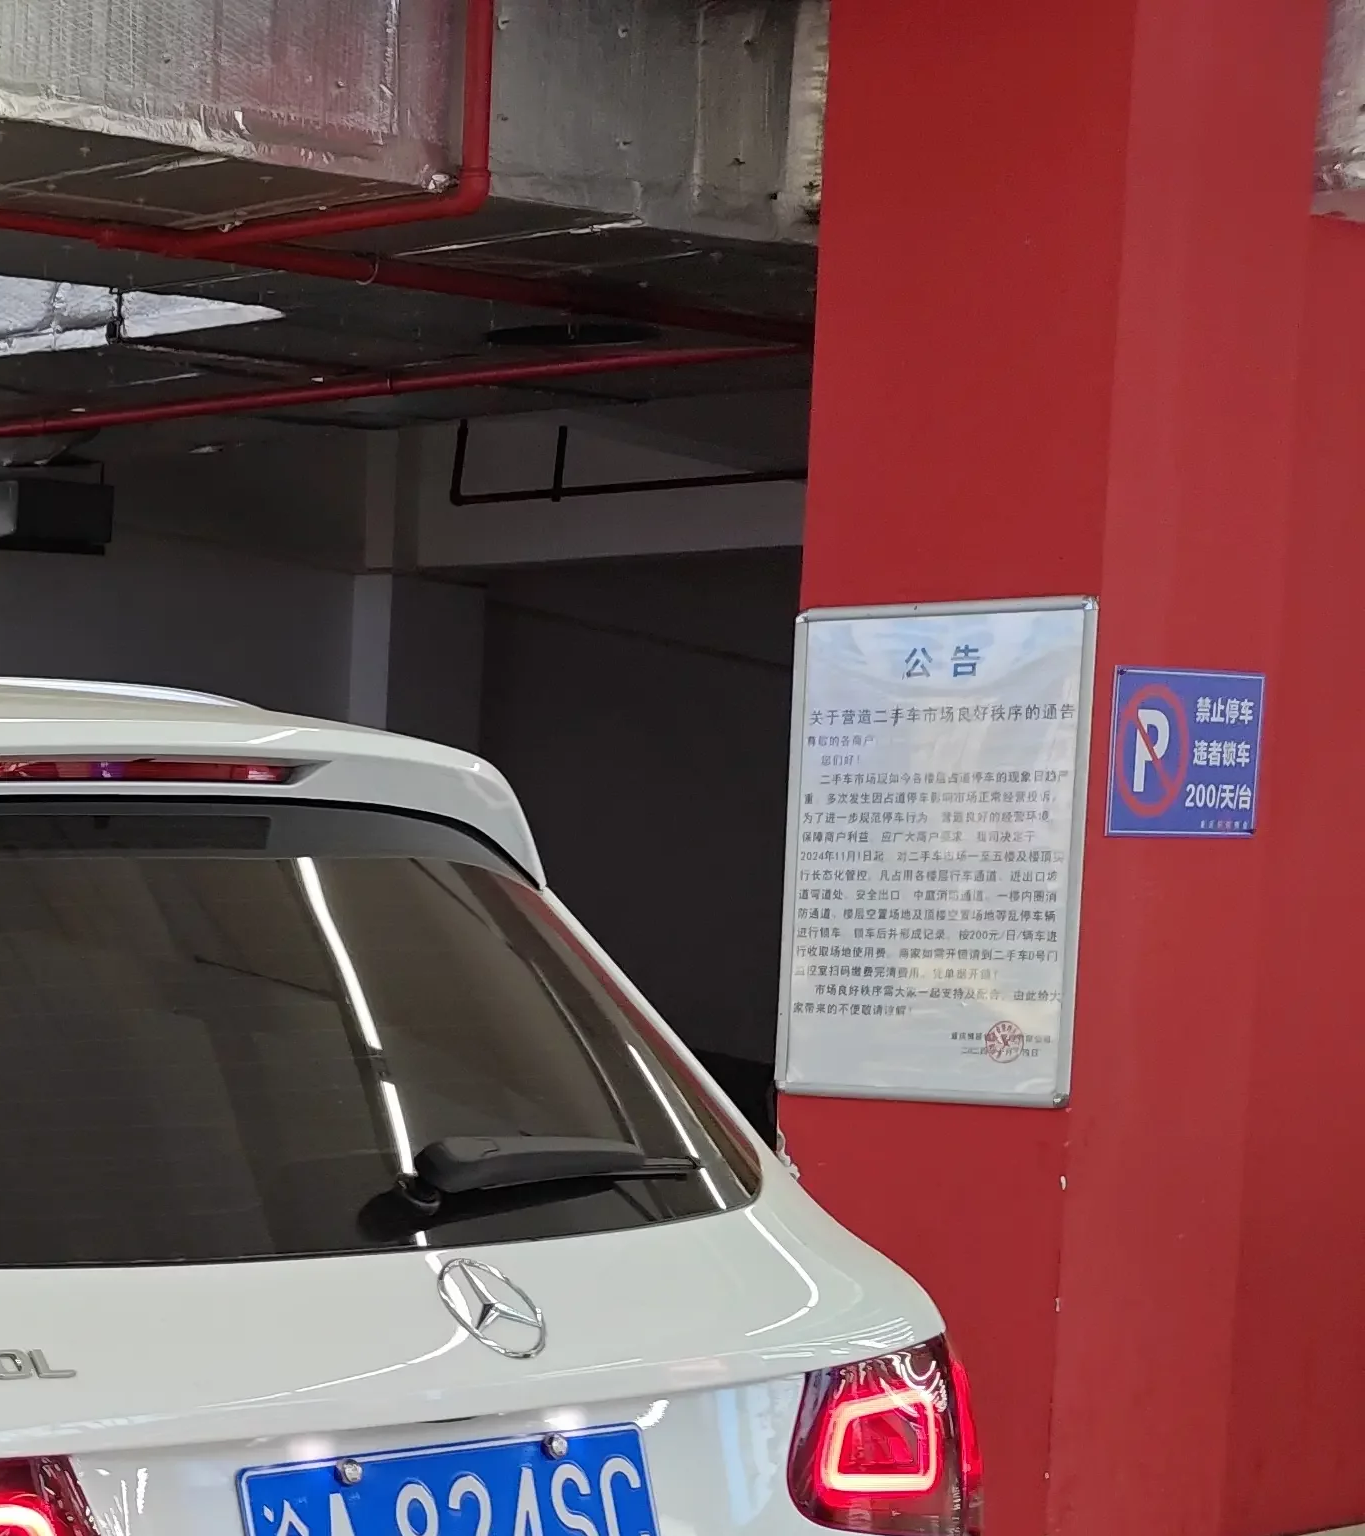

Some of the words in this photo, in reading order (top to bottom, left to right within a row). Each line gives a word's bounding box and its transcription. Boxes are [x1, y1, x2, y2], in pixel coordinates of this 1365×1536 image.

[904, 644, 980, 678] 公告
[809, 703, 1076, 726] 关于营造二手车市场良好秩序的通告
[1196, 697, 1254, 724] 禁止停车
[1133, 709, 1169, 792] P
[1193, 740, 1251, 767] 违者锁车
[1185, 784, 1252, 810] 200/天/台
